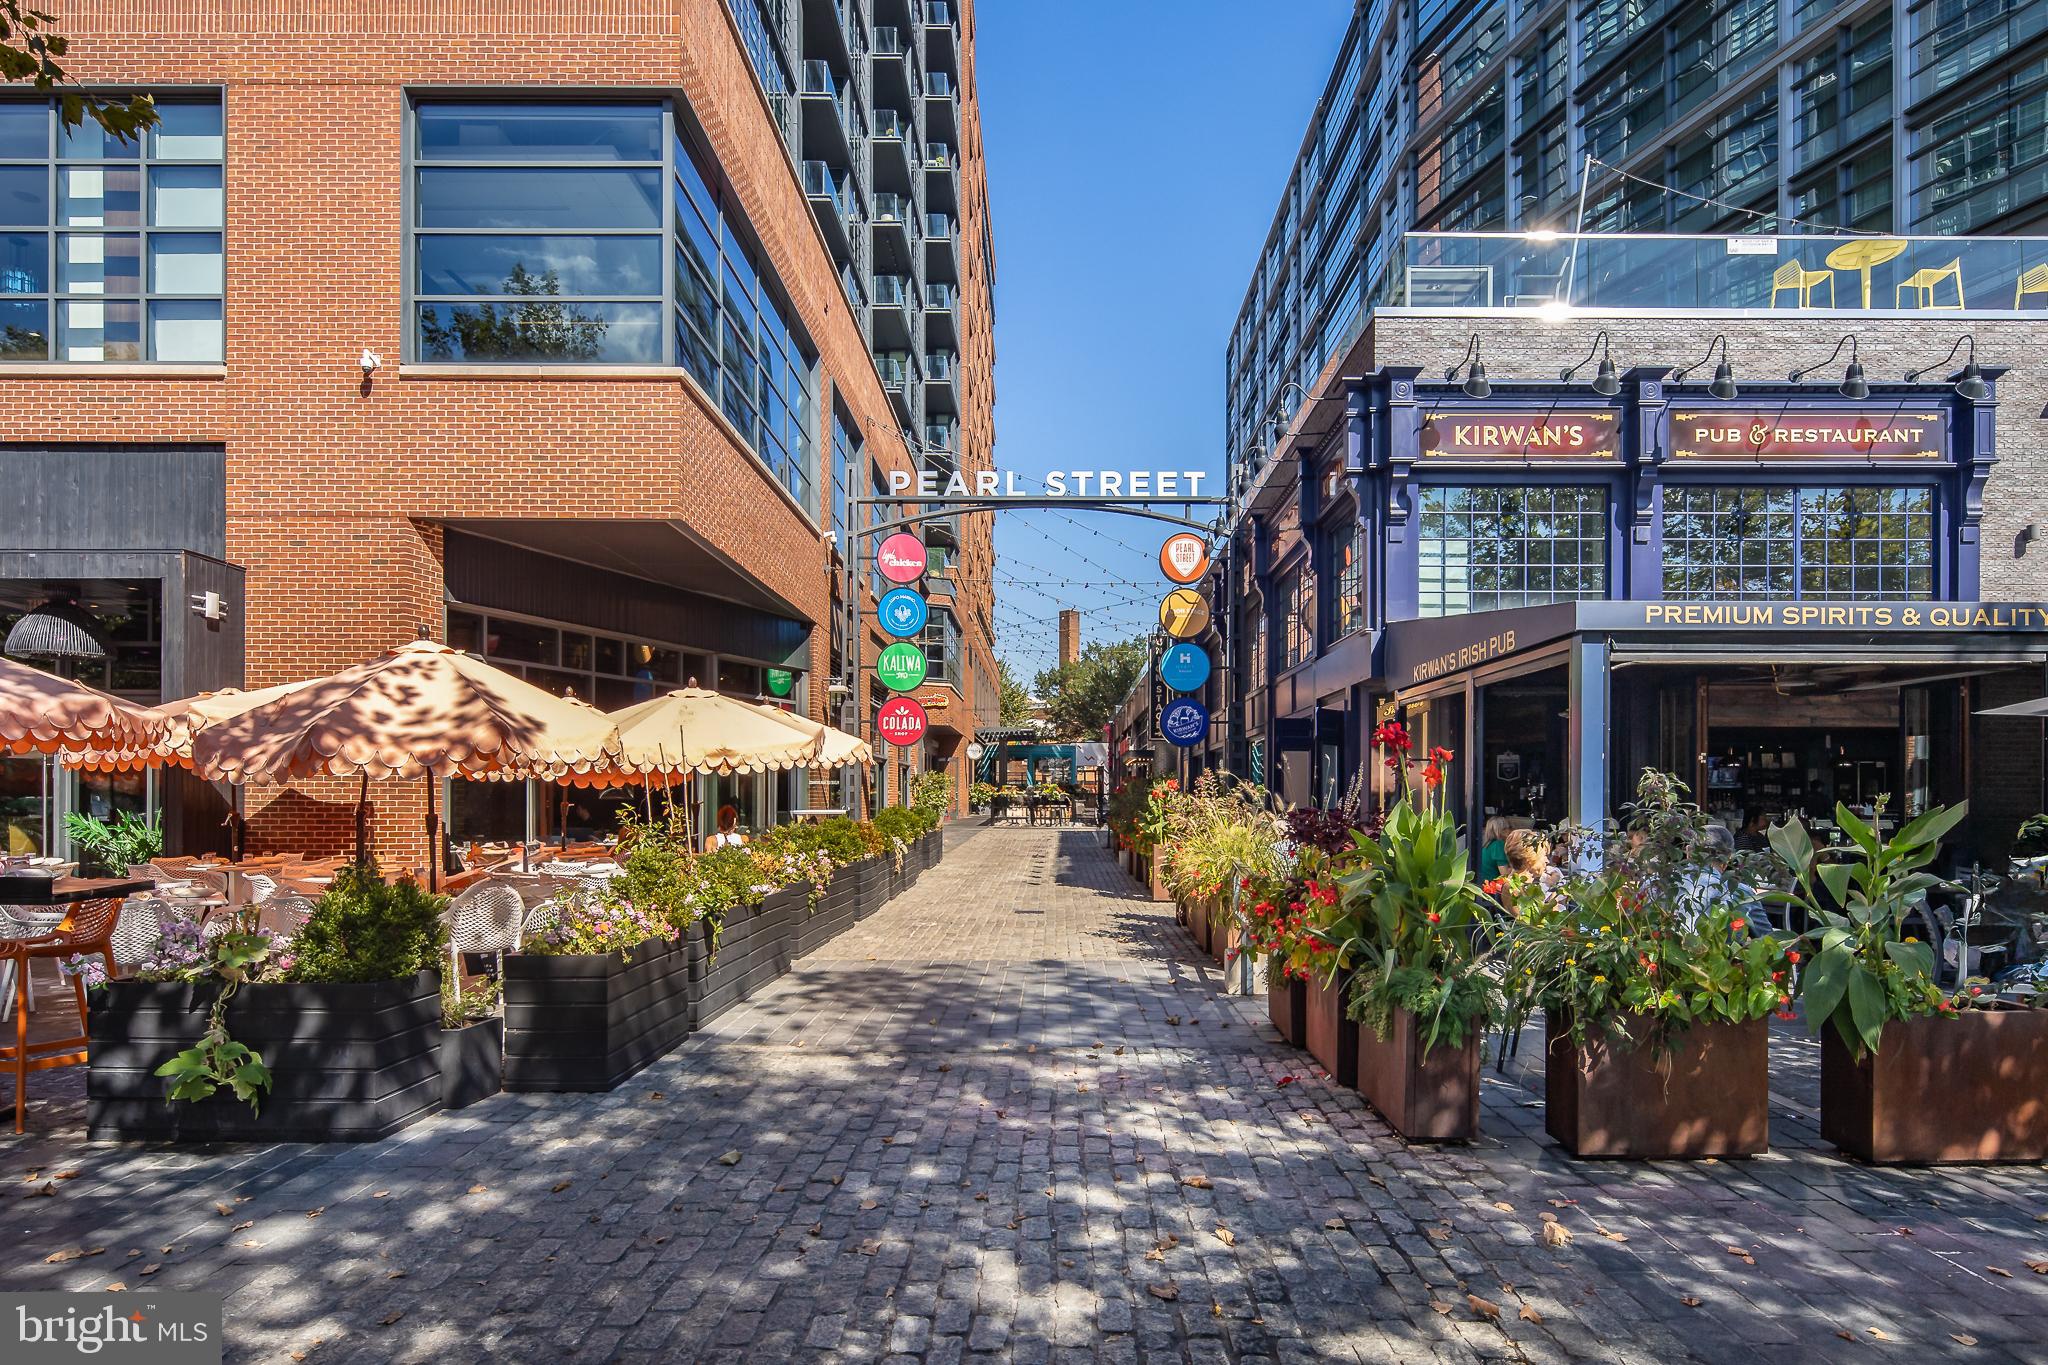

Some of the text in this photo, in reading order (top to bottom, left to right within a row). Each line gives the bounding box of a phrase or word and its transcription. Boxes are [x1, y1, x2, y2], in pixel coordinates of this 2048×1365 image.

[1454, 425, 1584, 446] KIRWAN'S
[1694, 424, 1924, 445] PUB & RESTAURANT
[889, 470, 1206, 497] PEARL STREET
[1175, 543, 1195, 553] PEARL
[1175, 553, 1195, 563] STREET
[1645, 605, 2048, 627] PREMIUM SPIRITS & QUALITY
[883, 654, 921, 672] KALIWA
[1412, 629, 1516, 683] KIRWAN'S IRISH PUB
[882, 716, 922, 731] COLADA
